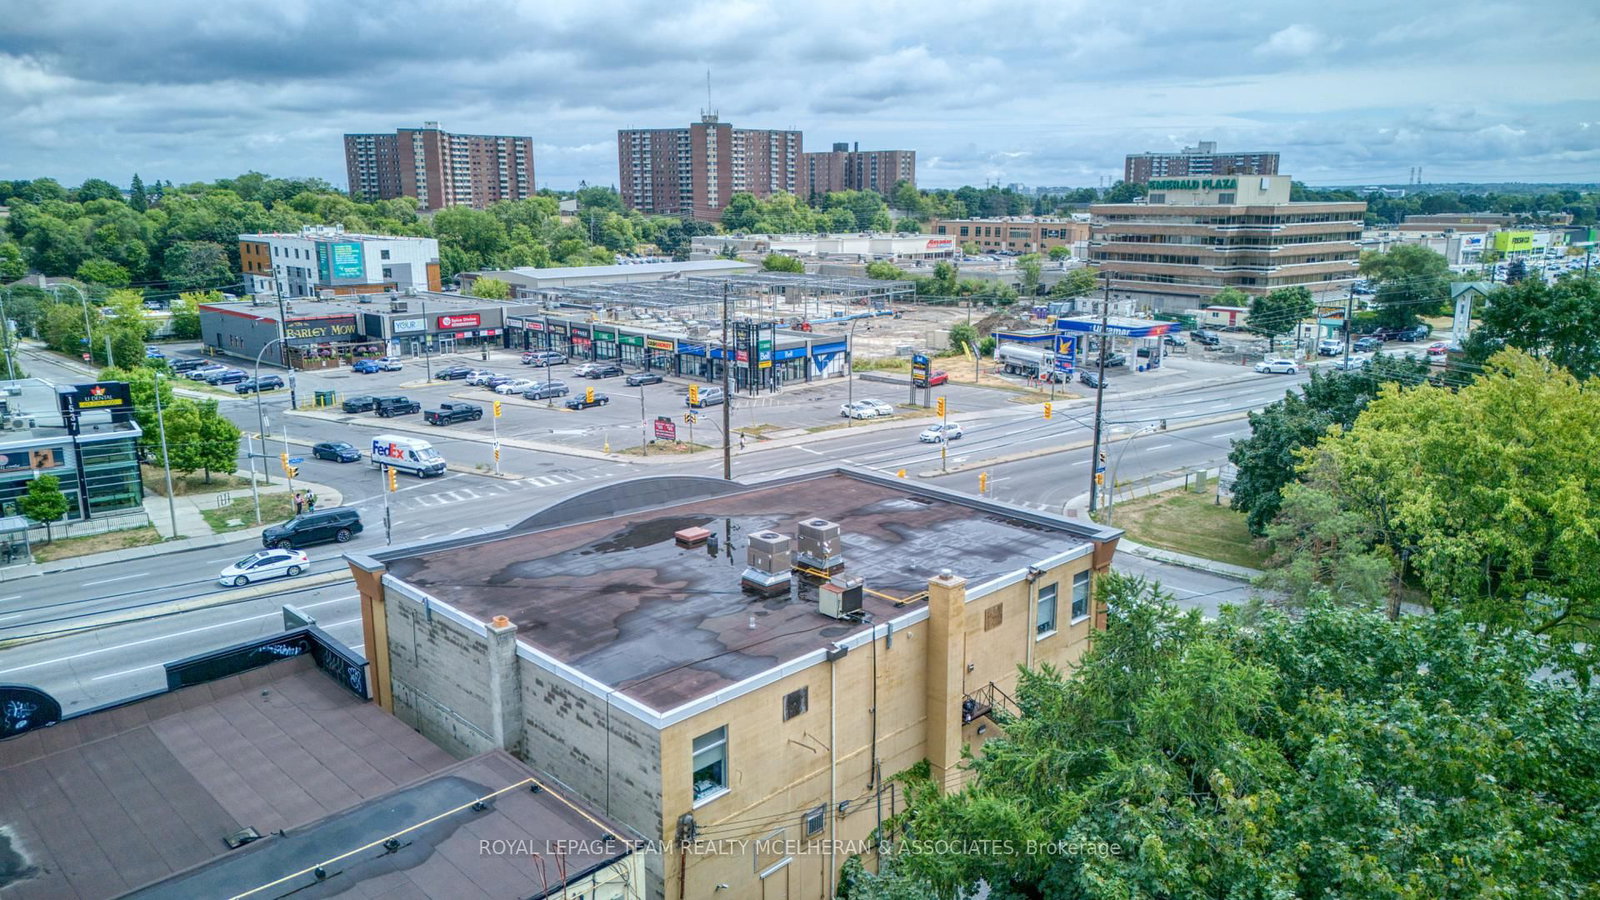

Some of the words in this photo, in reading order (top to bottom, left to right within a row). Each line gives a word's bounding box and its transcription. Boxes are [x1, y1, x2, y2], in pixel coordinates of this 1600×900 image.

[1148, 180, 1199, 190] EMERALD
[1202, 179, 1237, 190] PLAZA
[396, 321, 416, 330] YOUR
[286, 327, 327, 339] BARLEY
[331, 325, 356, 336] MOW
[373, 440, 404, 459] FedEx
